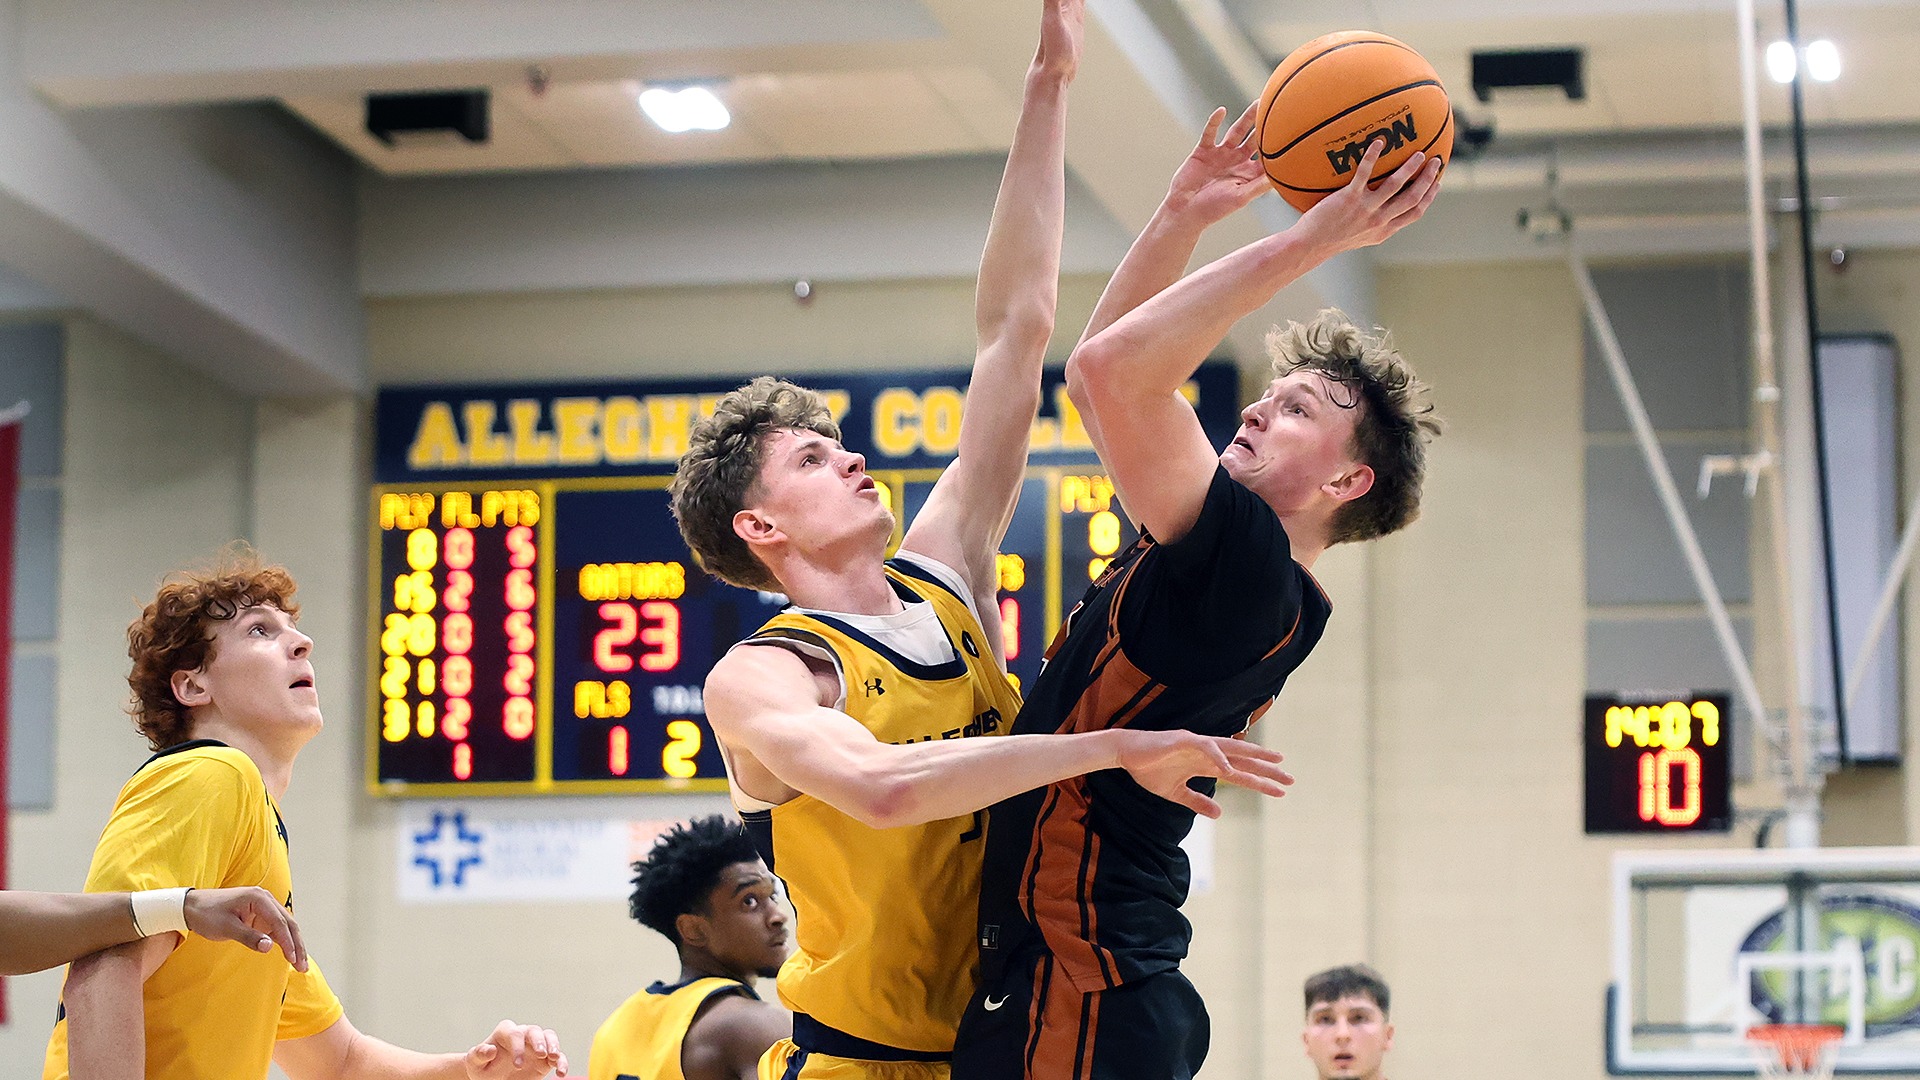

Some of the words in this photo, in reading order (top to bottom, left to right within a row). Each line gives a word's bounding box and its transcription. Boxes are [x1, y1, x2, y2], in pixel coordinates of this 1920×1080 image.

[1348, 123, 1375, 138] GAME
[1376, 104, 1410, 123] OFFICIAL
[1323, 136, 1347, 146] BALL
[1326, 112, 1418, 175] NCAA
[481, 489, 540, 527] PTS
[505, 525, 538, 569] 5
[442, 570, 475, 612] 2
[504, 568, 536, 611] 6
[503, 610, 536, 654] 5
[593, 601, 680, 673] 23
[380, 656, 436, 699] 21
[503, 653, 535, 697] 2
[382, 698, 435, 742] 31
[440, 697, 472, 741] 2
[574, 680, 631, 719] FLS
[1605, 700, 1720, 751] 14:07
[453, 741, 473, 781] 1
[608, 725, 630, 776] 1
[662, 720, 701, 778] 2
[1637, 747, 1702, 827] 10
